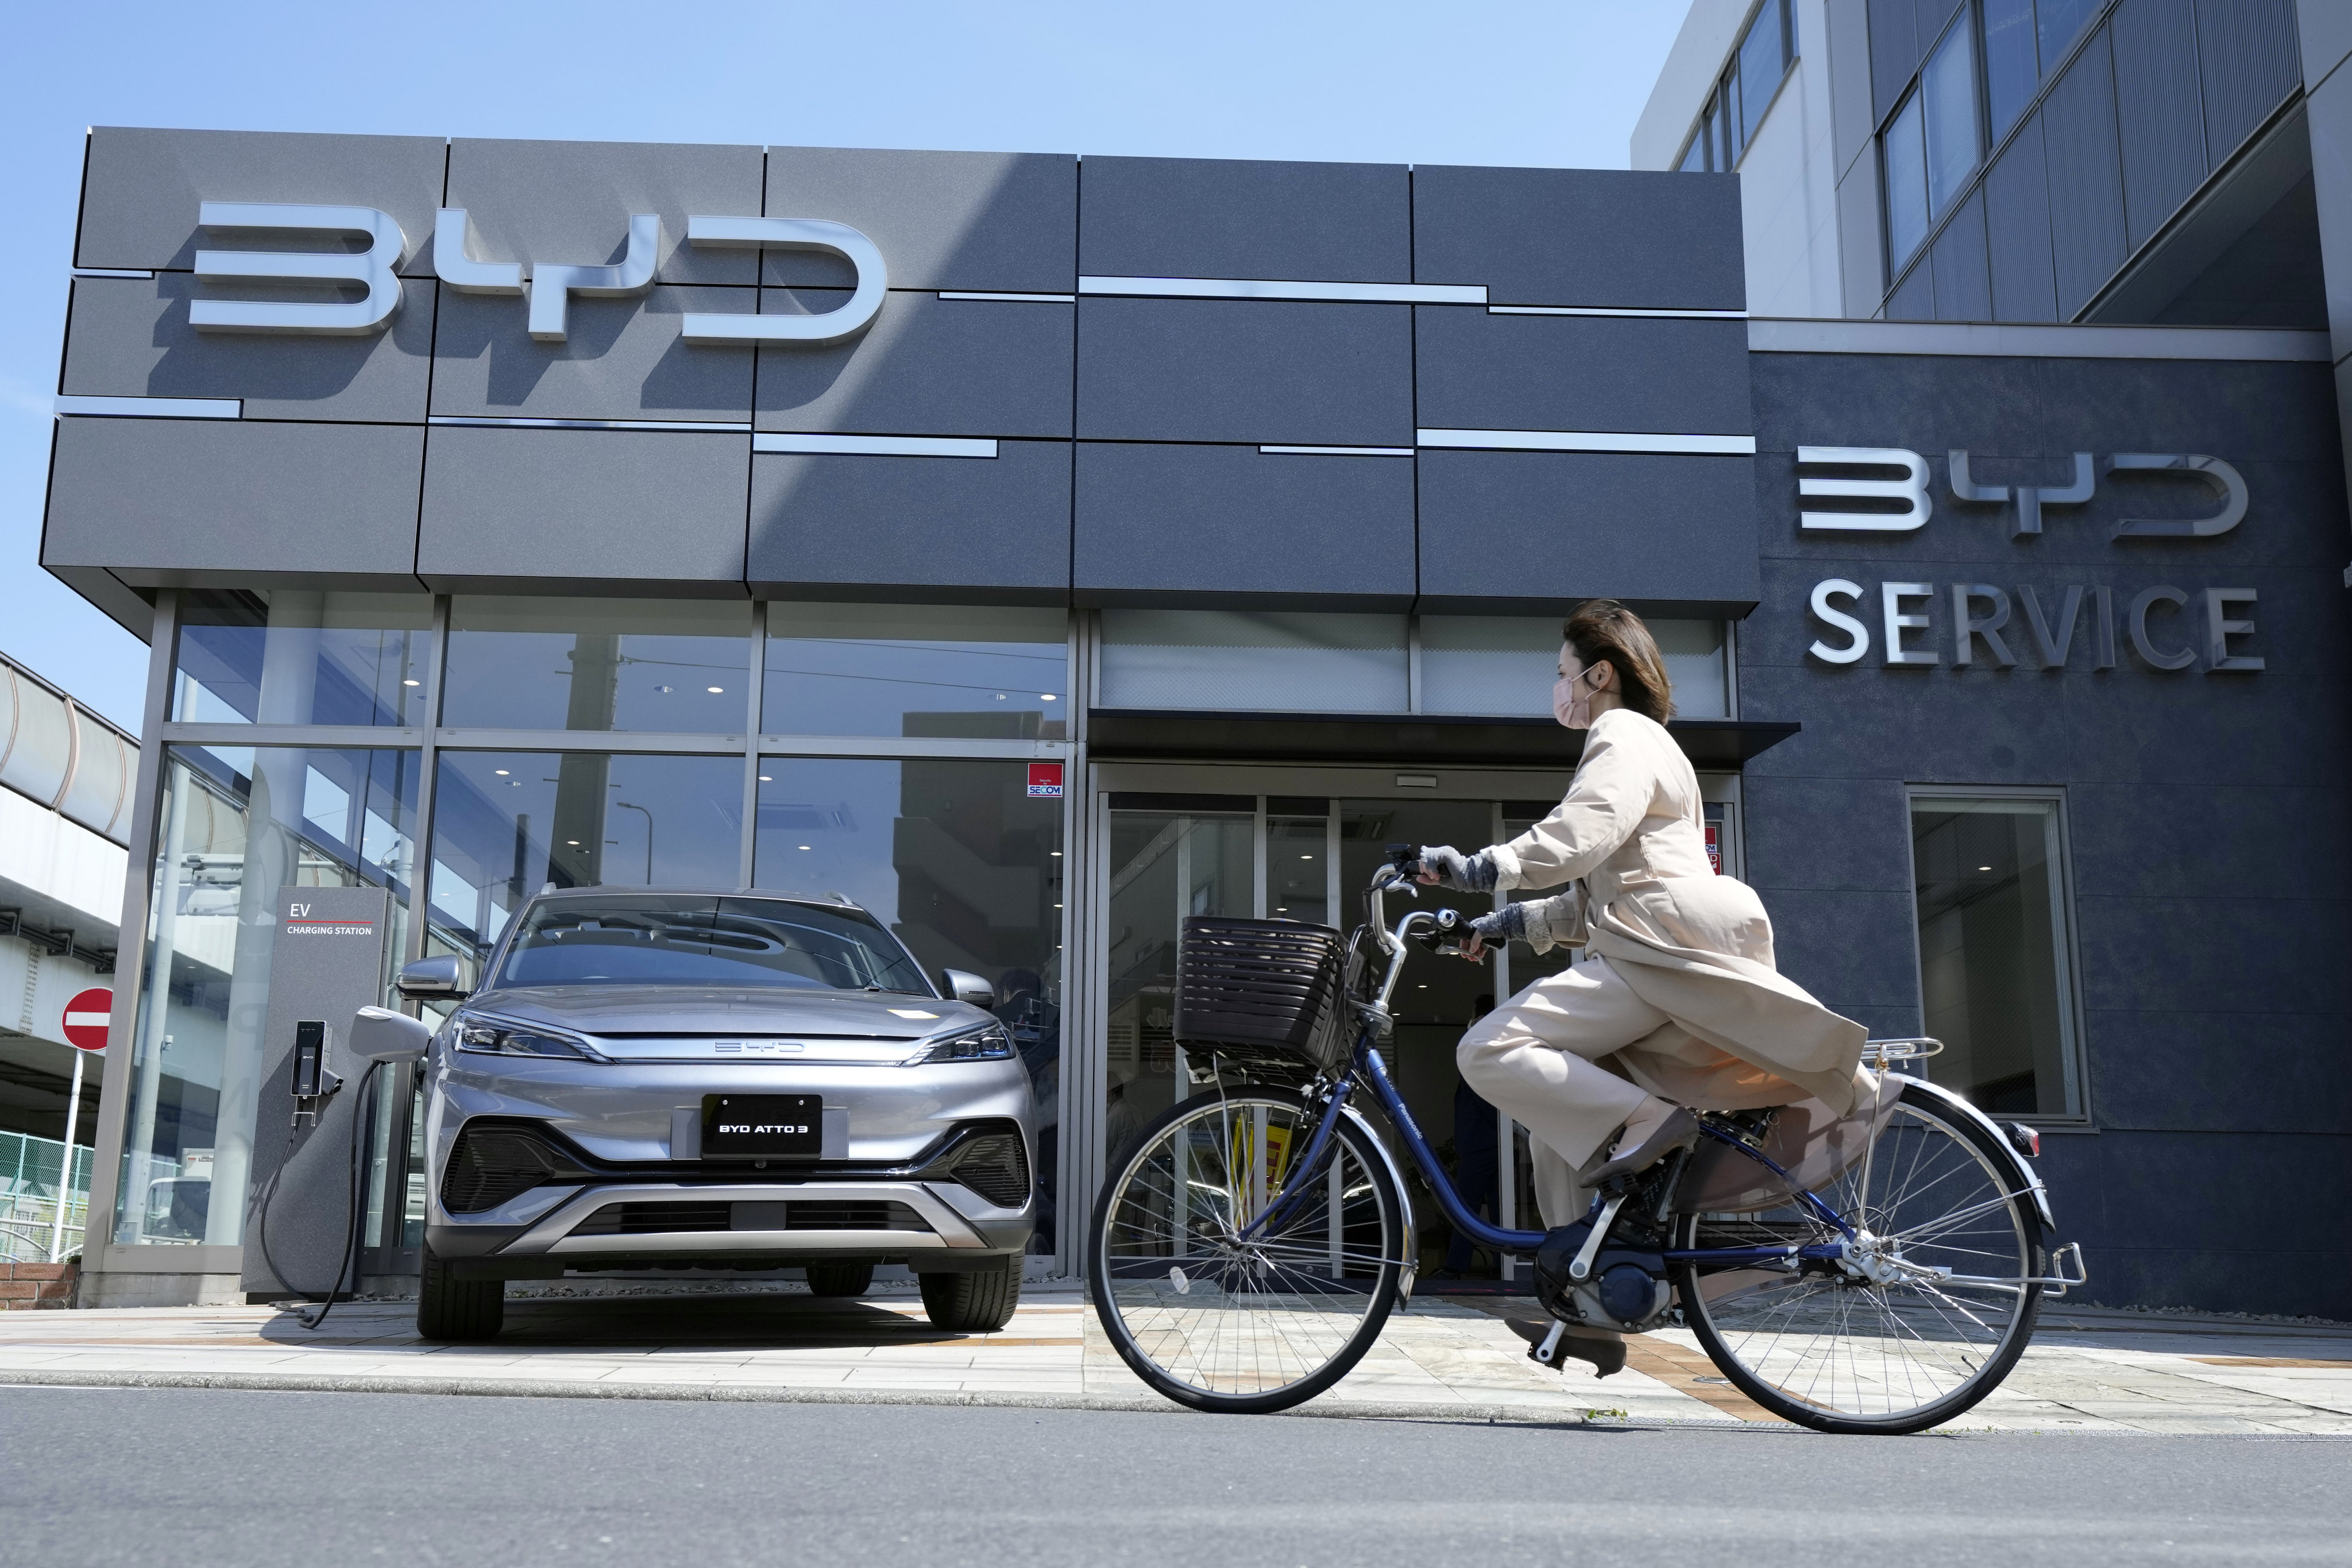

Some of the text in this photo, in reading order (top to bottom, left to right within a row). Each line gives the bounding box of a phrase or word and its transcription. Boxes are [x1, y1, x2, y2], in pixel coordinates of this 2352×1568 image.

[188, 202, 888, 346] BYD
[1797, 446, 2249, 541] BYD
[1807, 578, 2265, 673] SERVICE
[290, 903, 311, 917] EV
[715, 1041, 805, 1052] BYD
[1398, 1103, 1423, 1140] Panasonic
